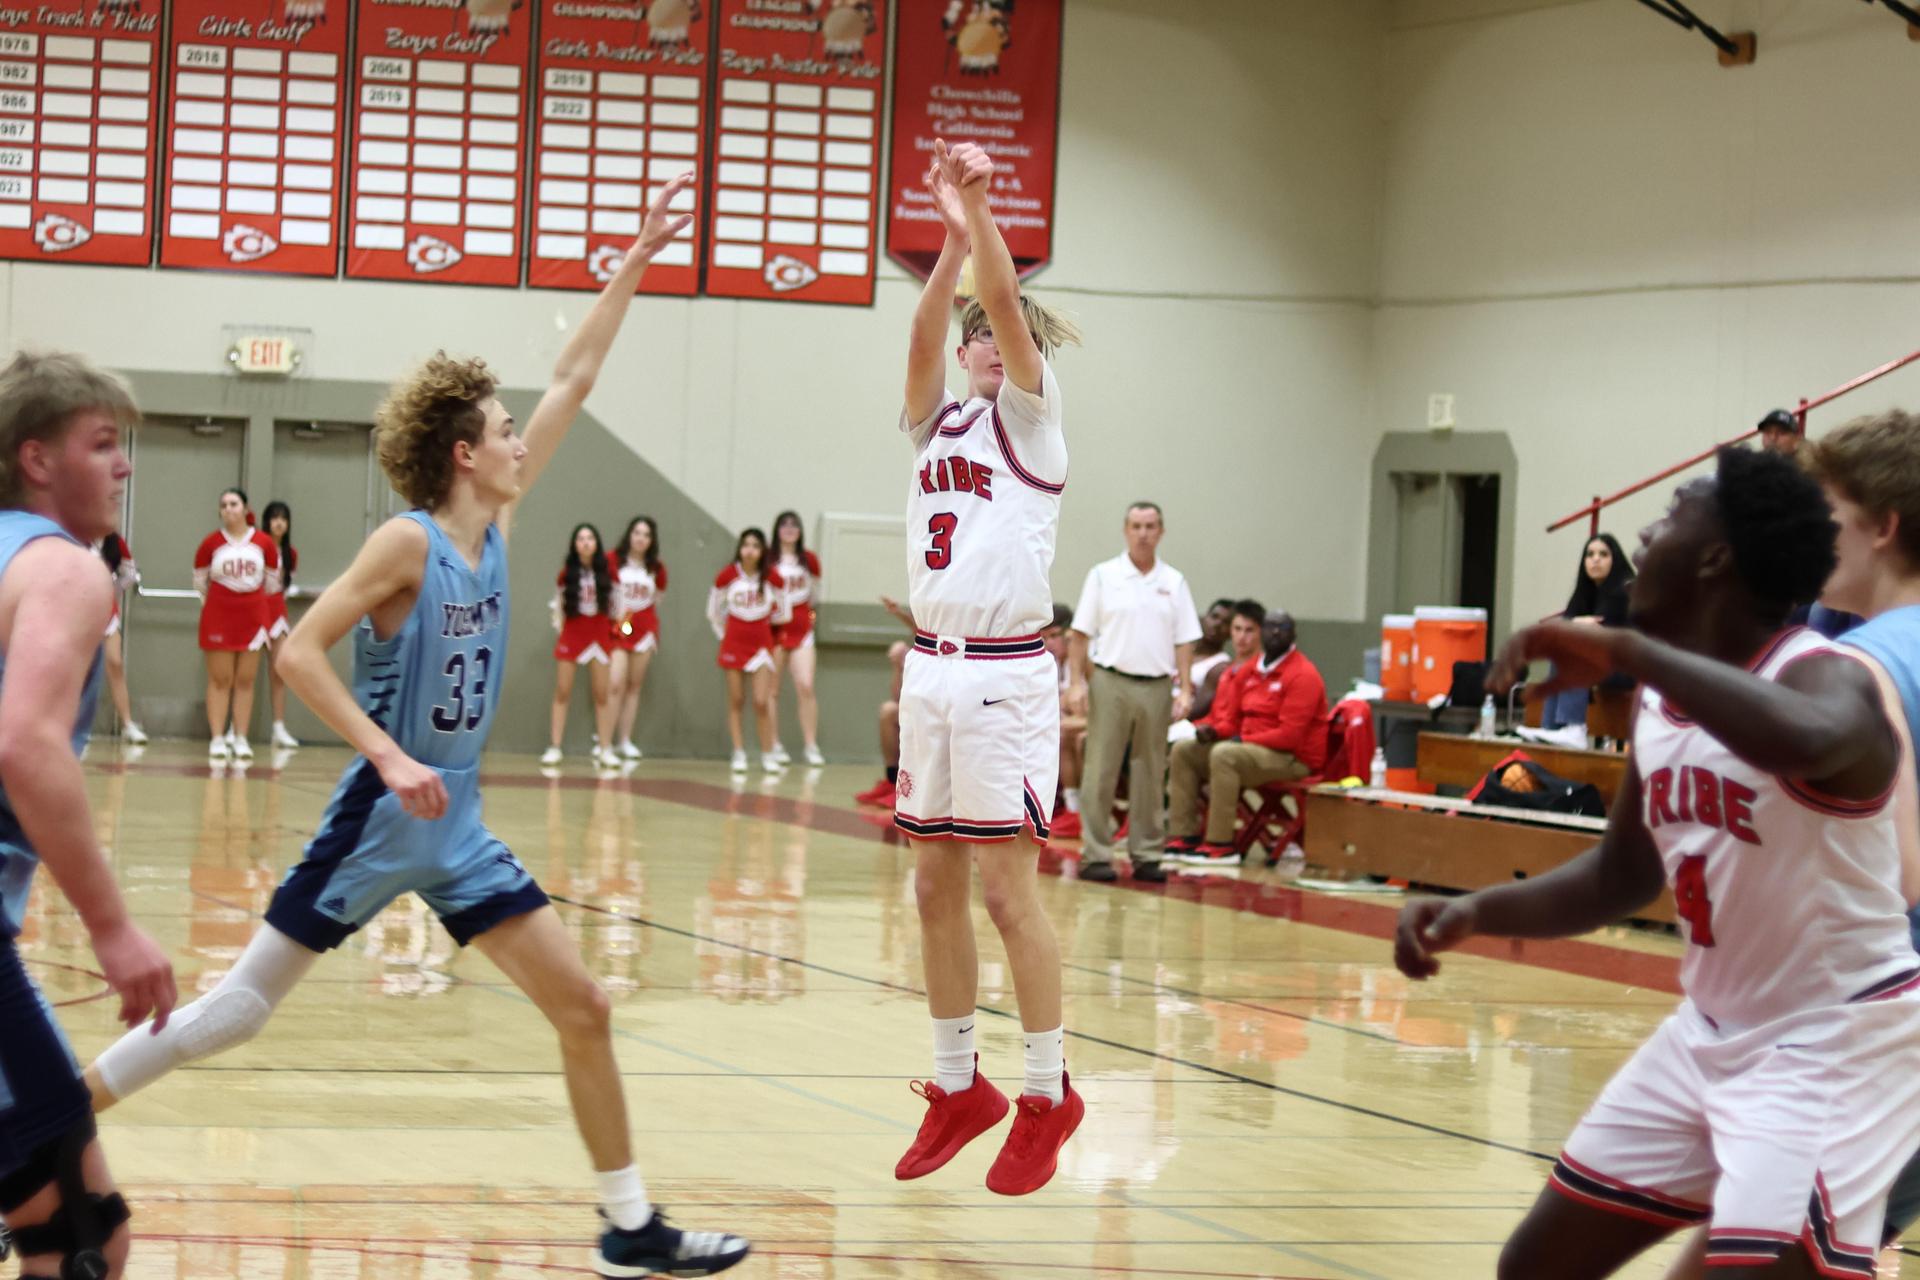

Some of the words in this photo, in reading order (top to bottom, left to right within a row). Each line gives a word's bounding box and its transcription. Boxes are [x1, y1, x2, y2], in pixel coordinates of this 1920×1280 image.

[0, 8, 31, 27] oys
[37, 6, 85, 27] Track
[111, 11, 158, 33] Field
[199, 15, 252, 38] Girls
[256, 19, 313, 45] Golf
[385, 27, 438, 54] Boys
[443, 32, 498, 57] Golf
[545, 37, 590, 58] Girls
[187, 49, 219, 63] 2018
[721, 48, 767, 74] Boys
[0, 65, 28, 79] 982
[369, 61, 402, 75] 2004
[1, 94, 27, 108] 986
[551, 101, 584, 115] 2022
[927, 103, 967, 120] High
[970, 105, 1024, 121] School
[0, 123, 25, 136] 987
[933, 120, 1015, 139] California
[0, 153, 23, 165] 022
[0, 182, 21, 193] 023
[988, 193, 1041, 210] ivision
[251, 340, 282, 365] EXIT
[919, 456, 993, 502] RIBE
[925, 512, 958, 570] 3
[430, 644, 492, 733] 33
[1642, 765, 1762, 846] RIBE
[1675, 854, 1716, 948] 4
